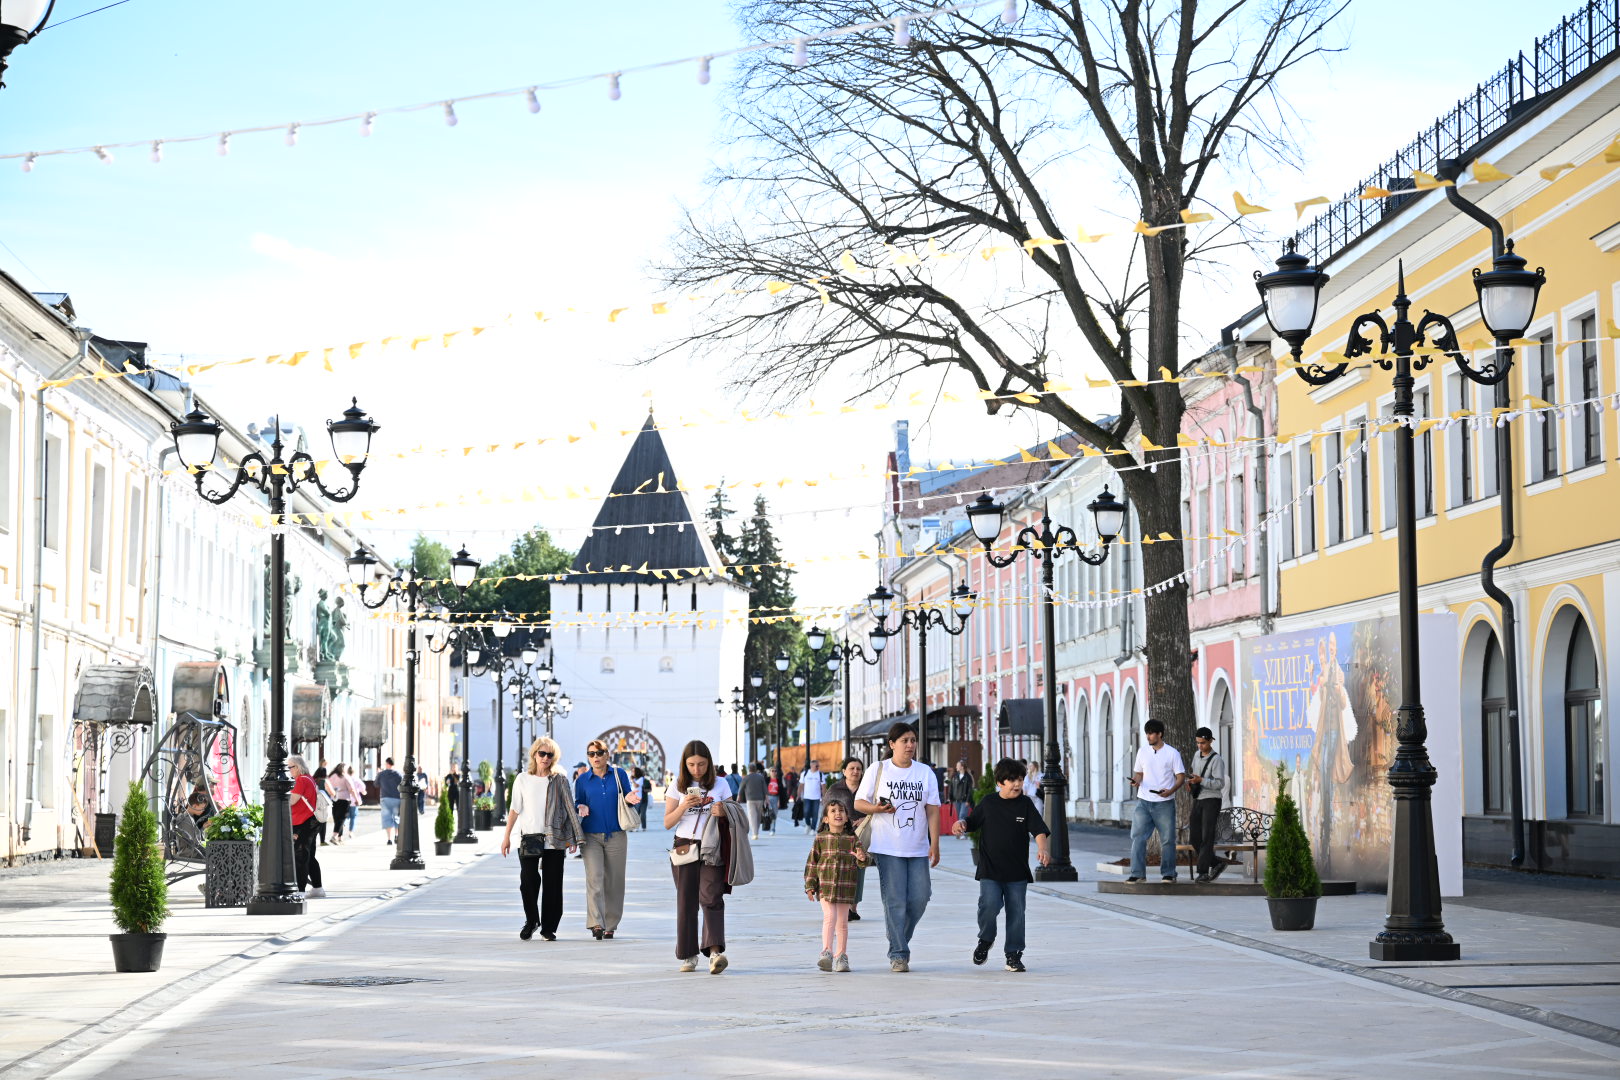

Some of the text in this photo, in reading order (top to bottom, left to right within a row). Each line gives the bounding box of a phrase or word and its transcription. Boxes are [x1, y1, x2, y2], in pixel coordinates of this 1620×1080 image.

[1265, 654, 1312, 687] УЛИЦА
[1268, 734, 1313, 750] СКОРО В КИНО
[886, 779, 924, 791] ЧАЙНЫЙ
[889, 790, 923, 801] АЛКАШ
